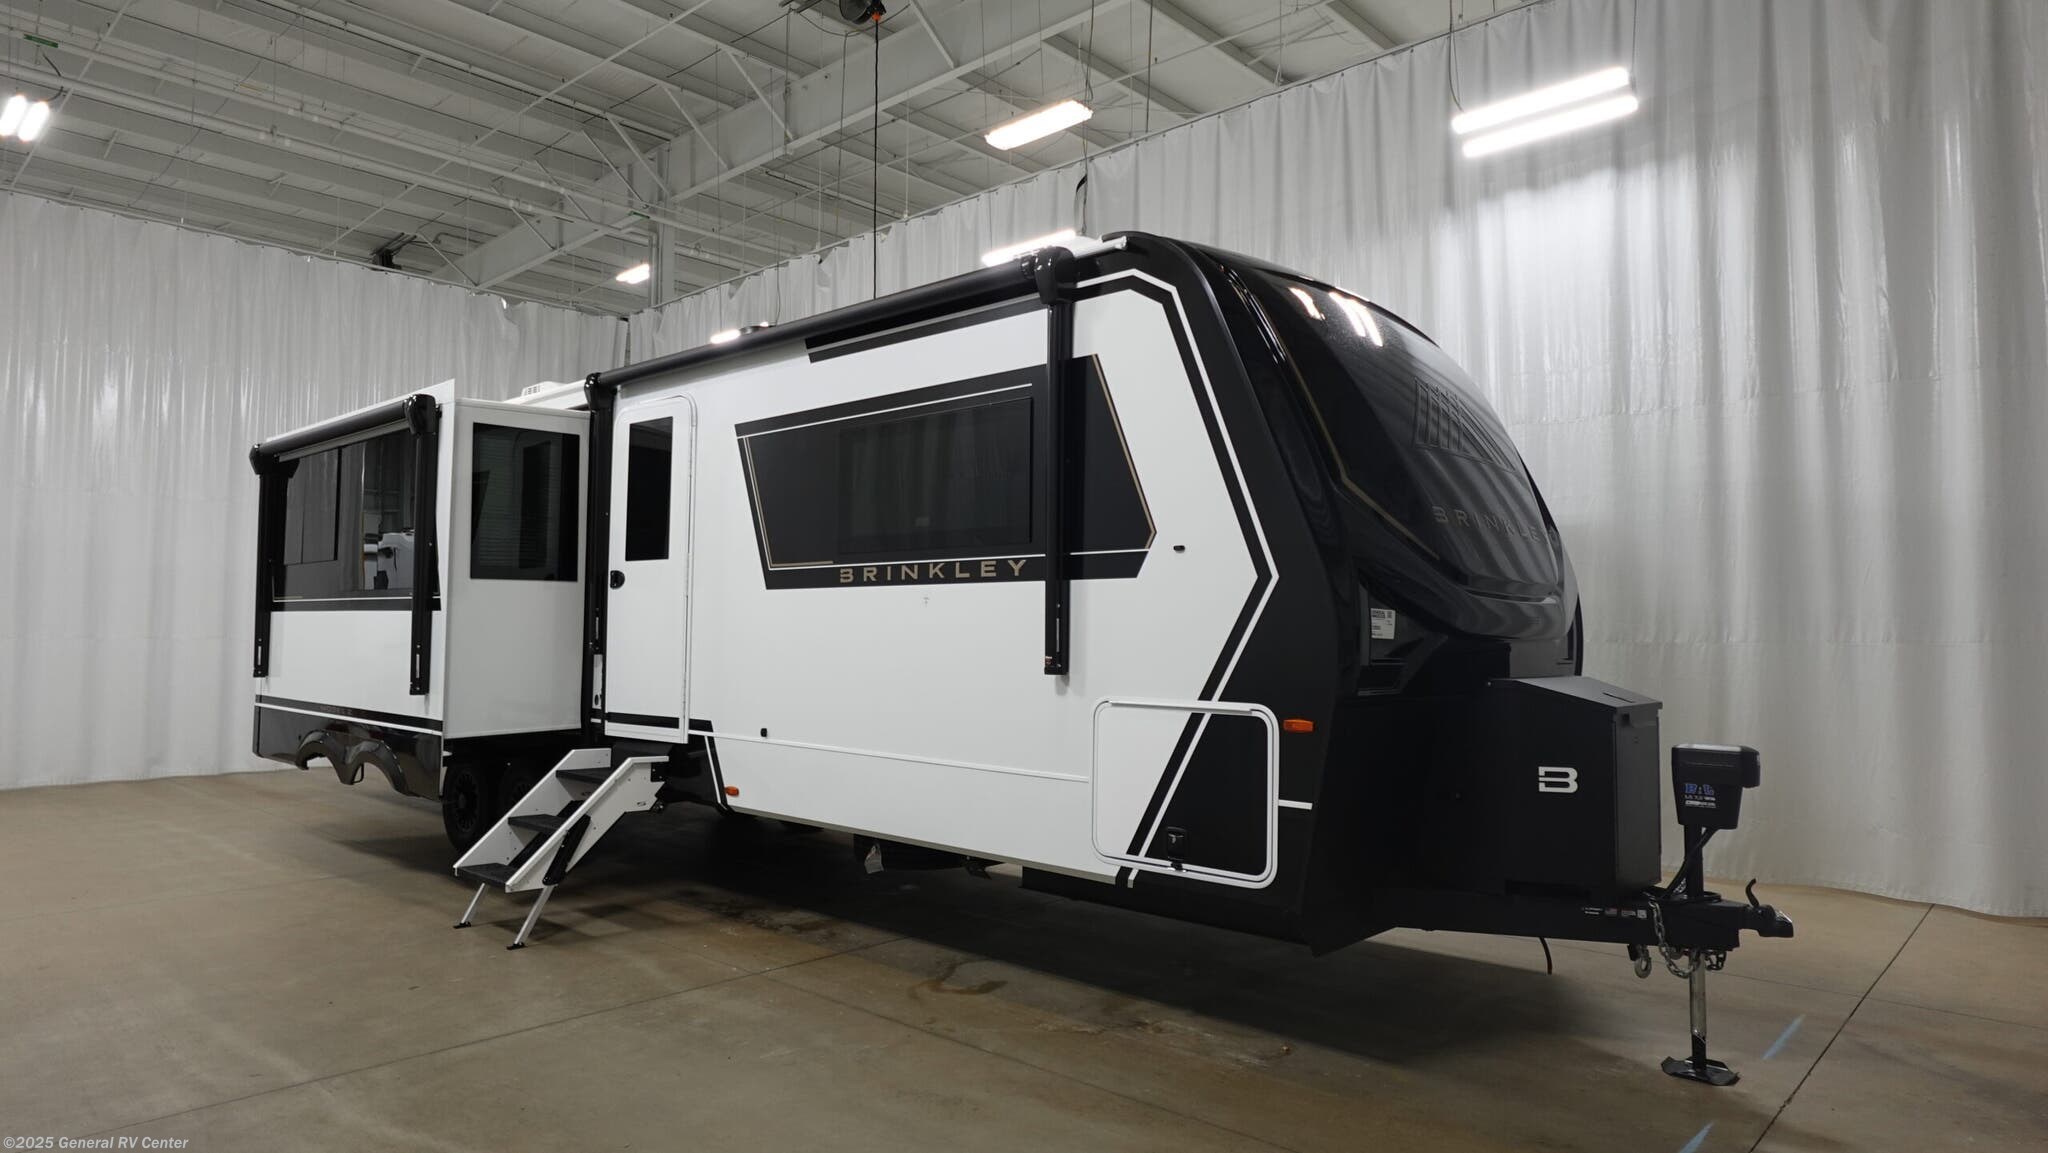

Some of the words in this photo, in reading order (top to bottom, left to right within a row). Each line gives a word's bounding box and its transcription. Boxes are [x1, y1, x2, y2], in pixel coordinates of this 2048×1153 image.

[1431, 505, 1548, 542] BRINKLE
[839, 559, 1026, 583] BRINKLEY
[1538, 766, 1578, 793] B
